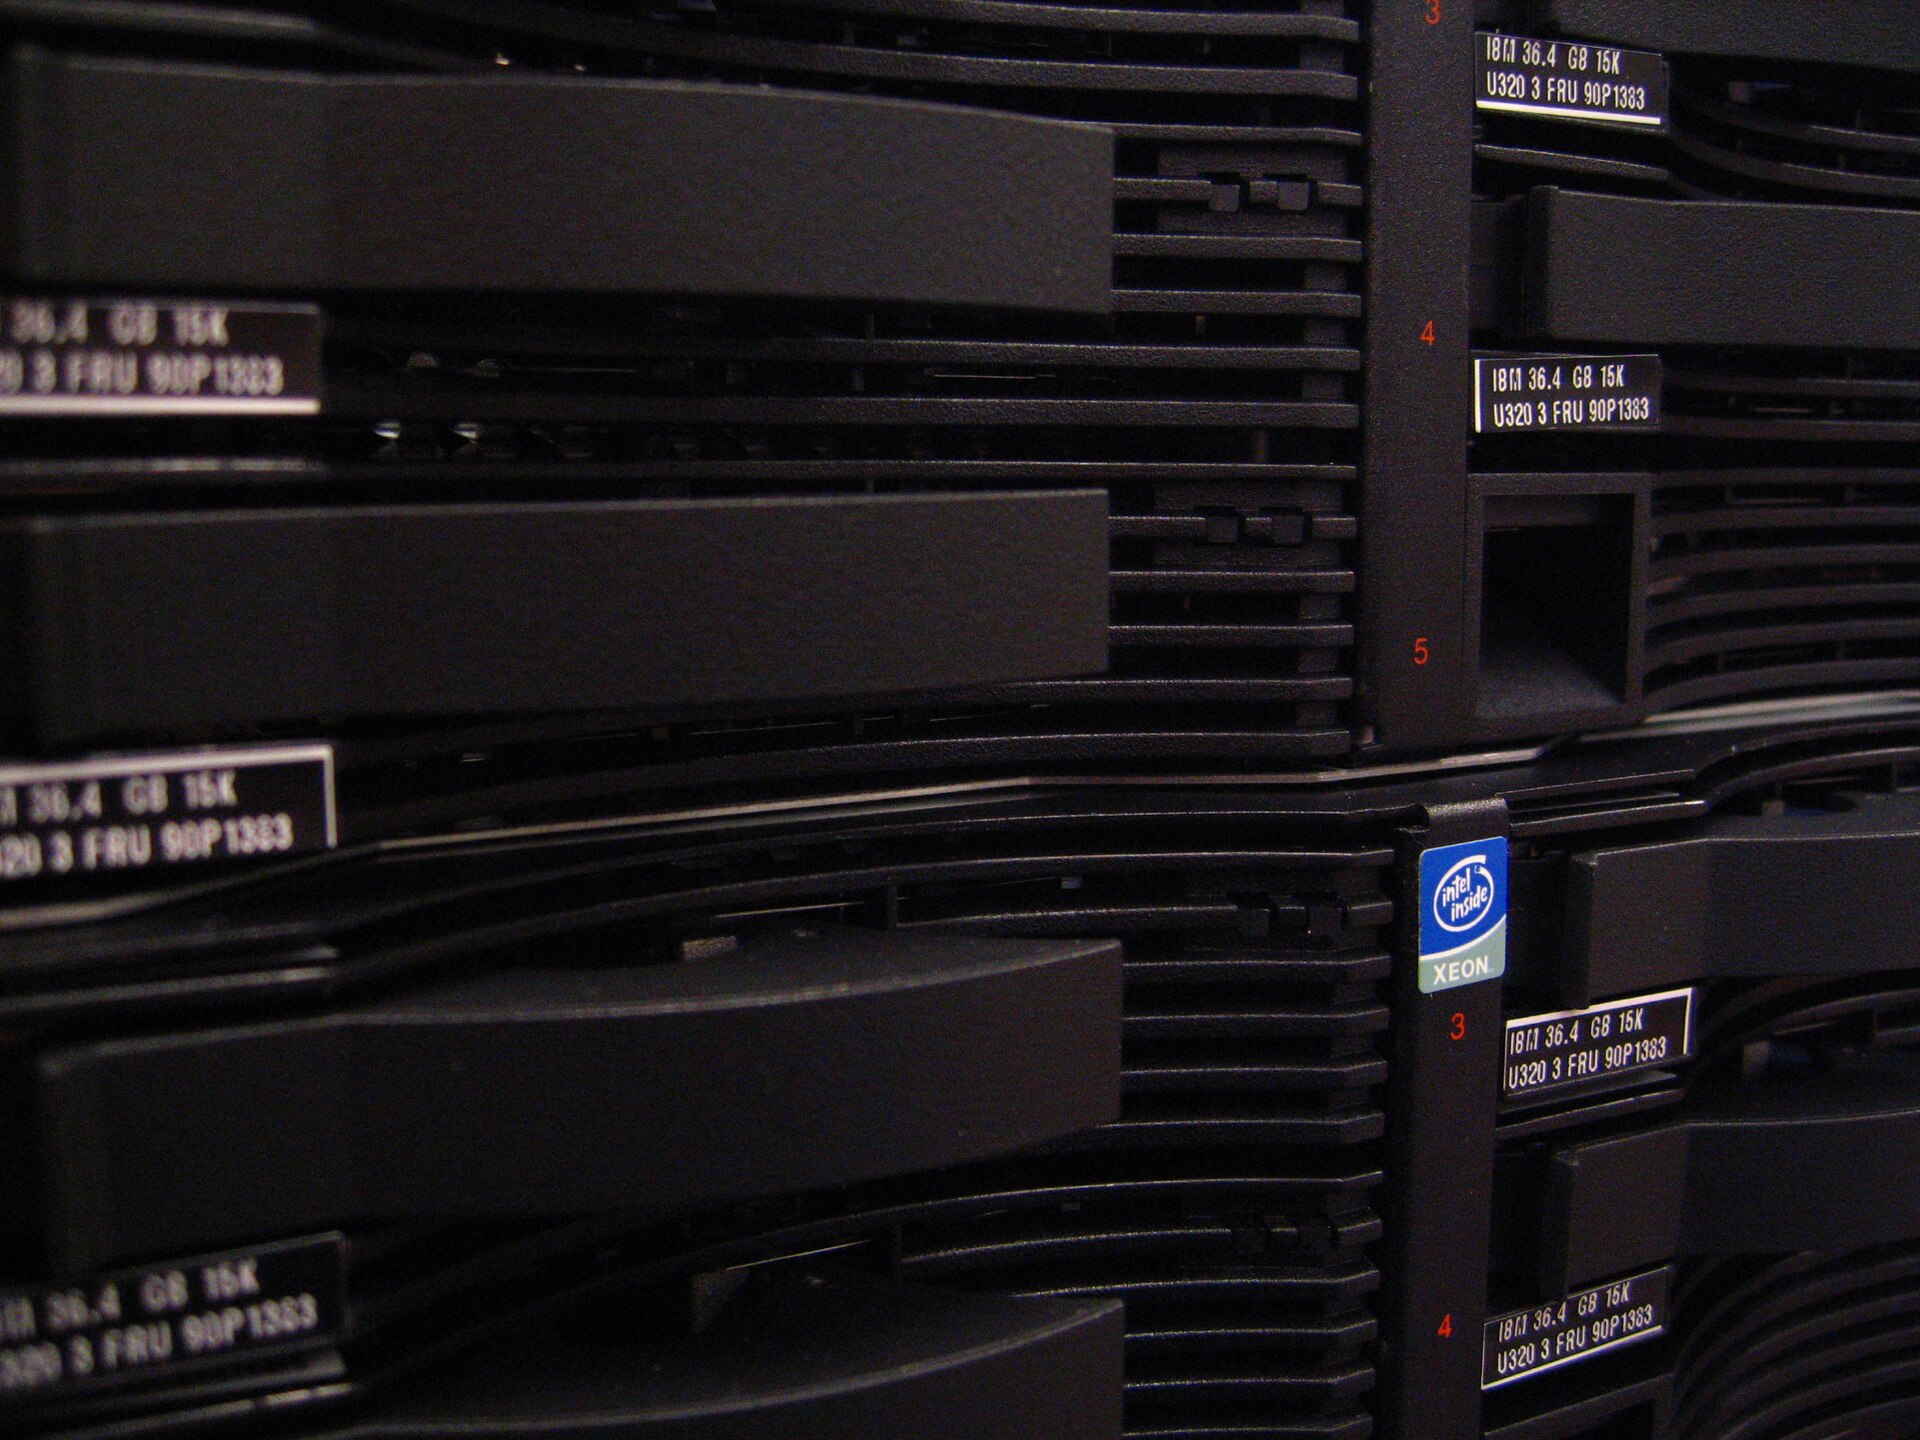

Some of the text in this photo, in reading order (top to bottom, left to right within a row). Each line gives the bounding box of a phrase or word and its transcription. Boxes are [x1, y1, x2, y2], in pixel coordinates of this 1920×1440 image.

[1425, 0, 1441, 26] 3
[1486, 36, 1621, 76] IBM 36.4 GB 15K
[1486, 71, 1646, 111] U320 3 FRU 90P1383
[1420, 319, 1436, 347] 4
[1492, 363, 1626, 393] IBM 36.4 GB 15K
[1493, 397, 1649, 428] U320 3 FRU 90P1383
[1413, 636, 1429, 666] 5
[1442, 867, 1471, 908] intel
[1450, 884, 1488, 923] inside
[1433, 955, 1489, 986] XEON
[1450, 1012, 1467, 1041] 3
[1509, 1007, 1645, 1056] IBM 36.4 GB 15K
[1508, 1035, 1667, 1090] U320 3 FRU 90P1383
[1437, 1313, 1453, 1338] 4
[1498, 1281, 1631, 1343] IBM 36.4 GB 15K
[1497, 1304, 1653, 1375] U320 3 FRU 90P1383
